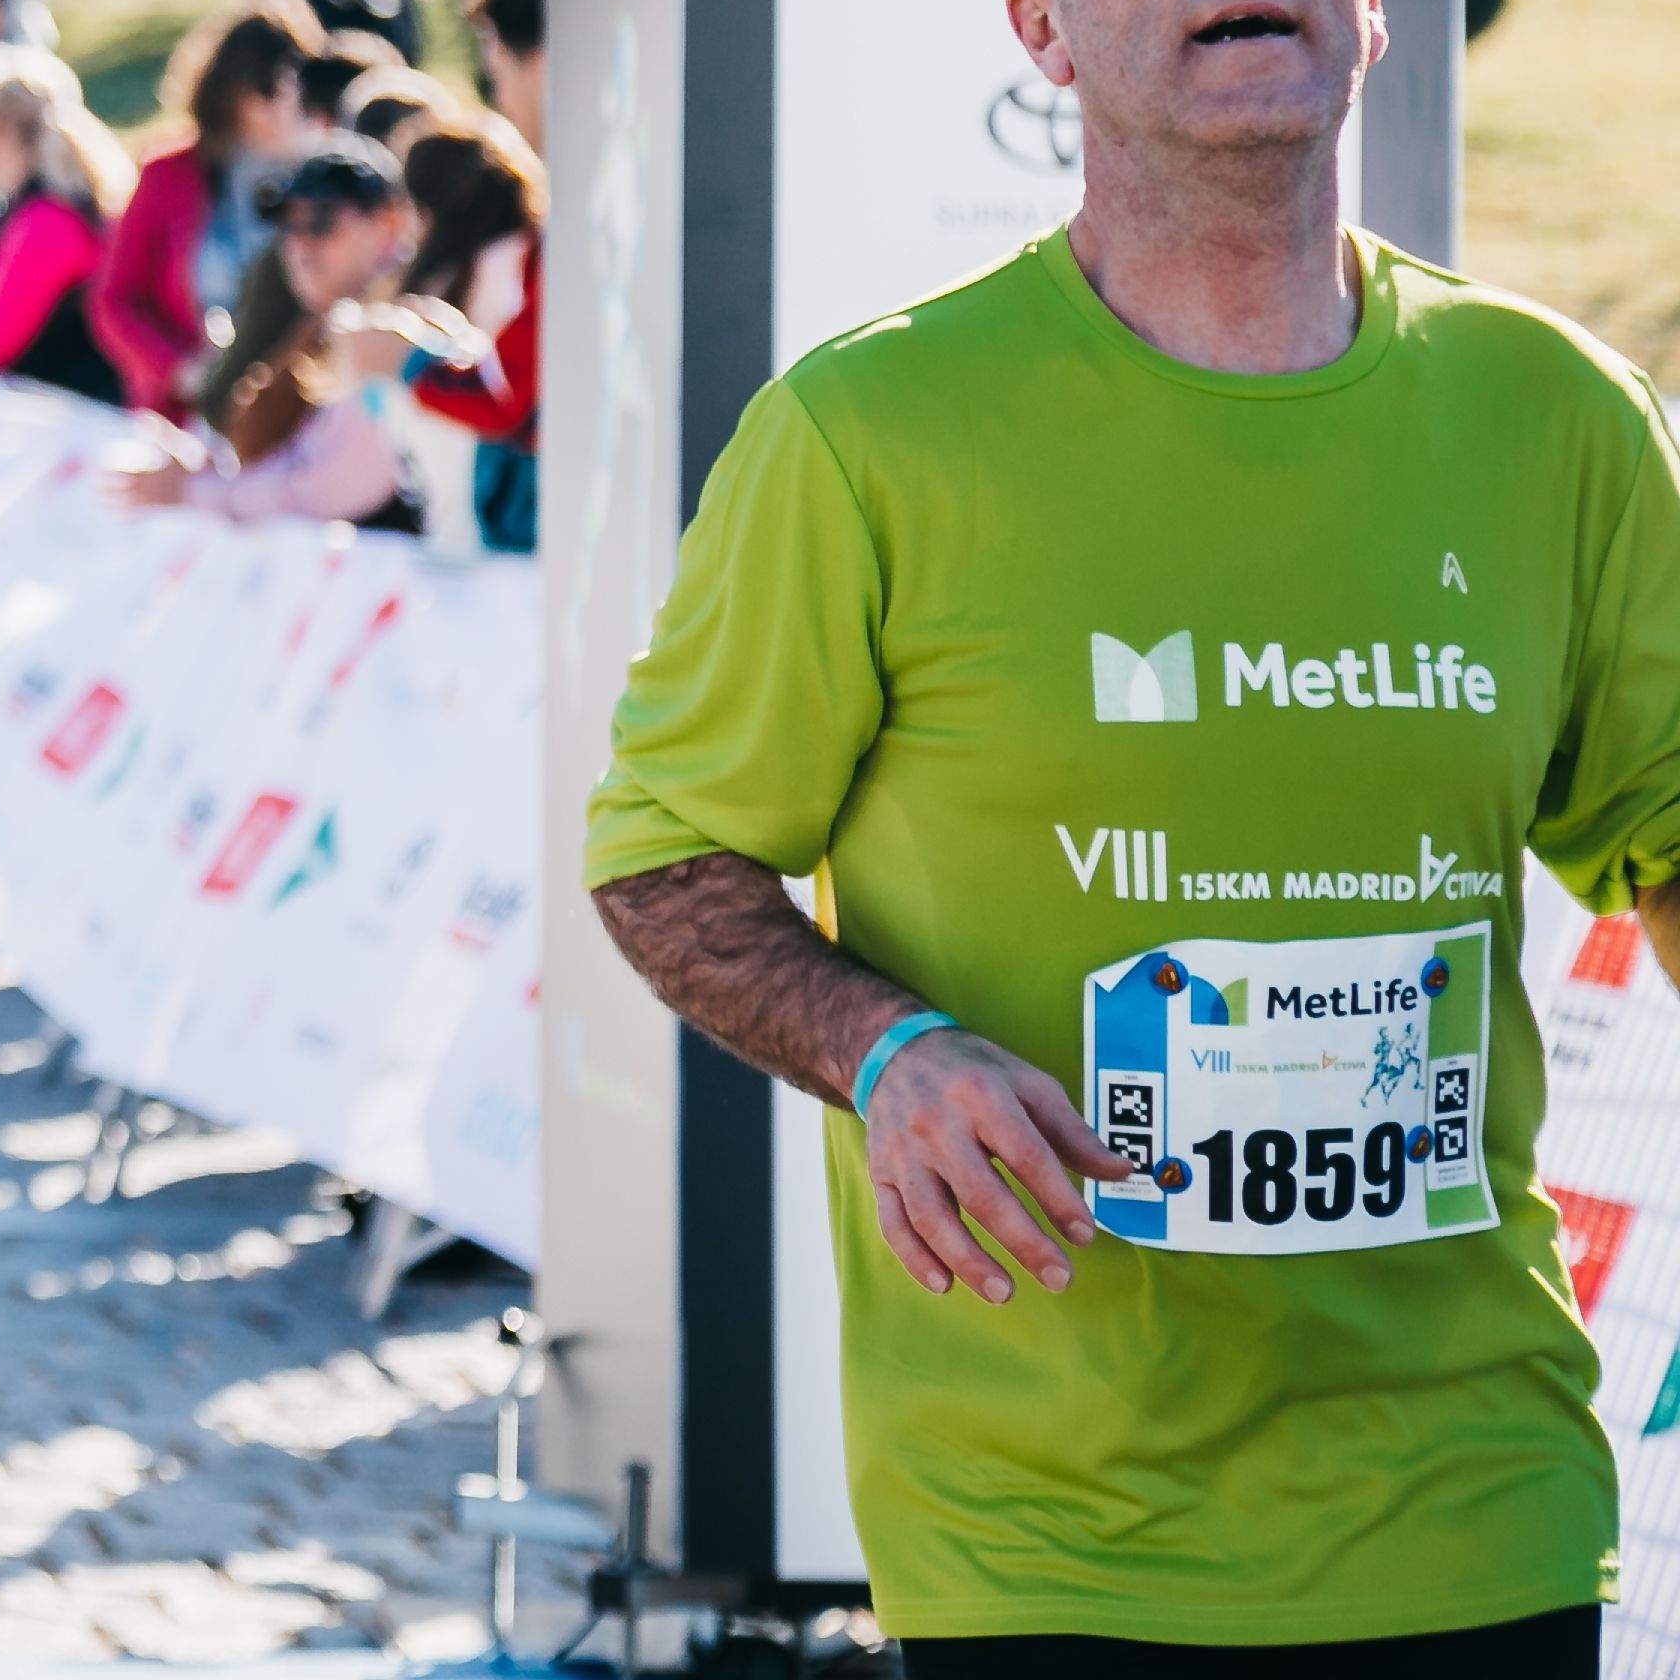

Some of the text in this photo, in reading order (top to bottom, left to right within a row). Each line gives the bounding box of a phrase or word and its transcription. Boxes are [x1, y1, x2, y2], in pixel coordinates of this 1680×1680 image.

[1222, 641, 1497, 714] MetLife
[1053, 824, 1168, 903] VIII
[1179, 871, 1271, 901] 15KM
[1283, 872, 1417, 902] MADRID
[1265, 977, 1418, 1020] MetLife
[1190, 1047, 1231, 1073] VIII
[1191, 1121, 1406, 1226] 1859
